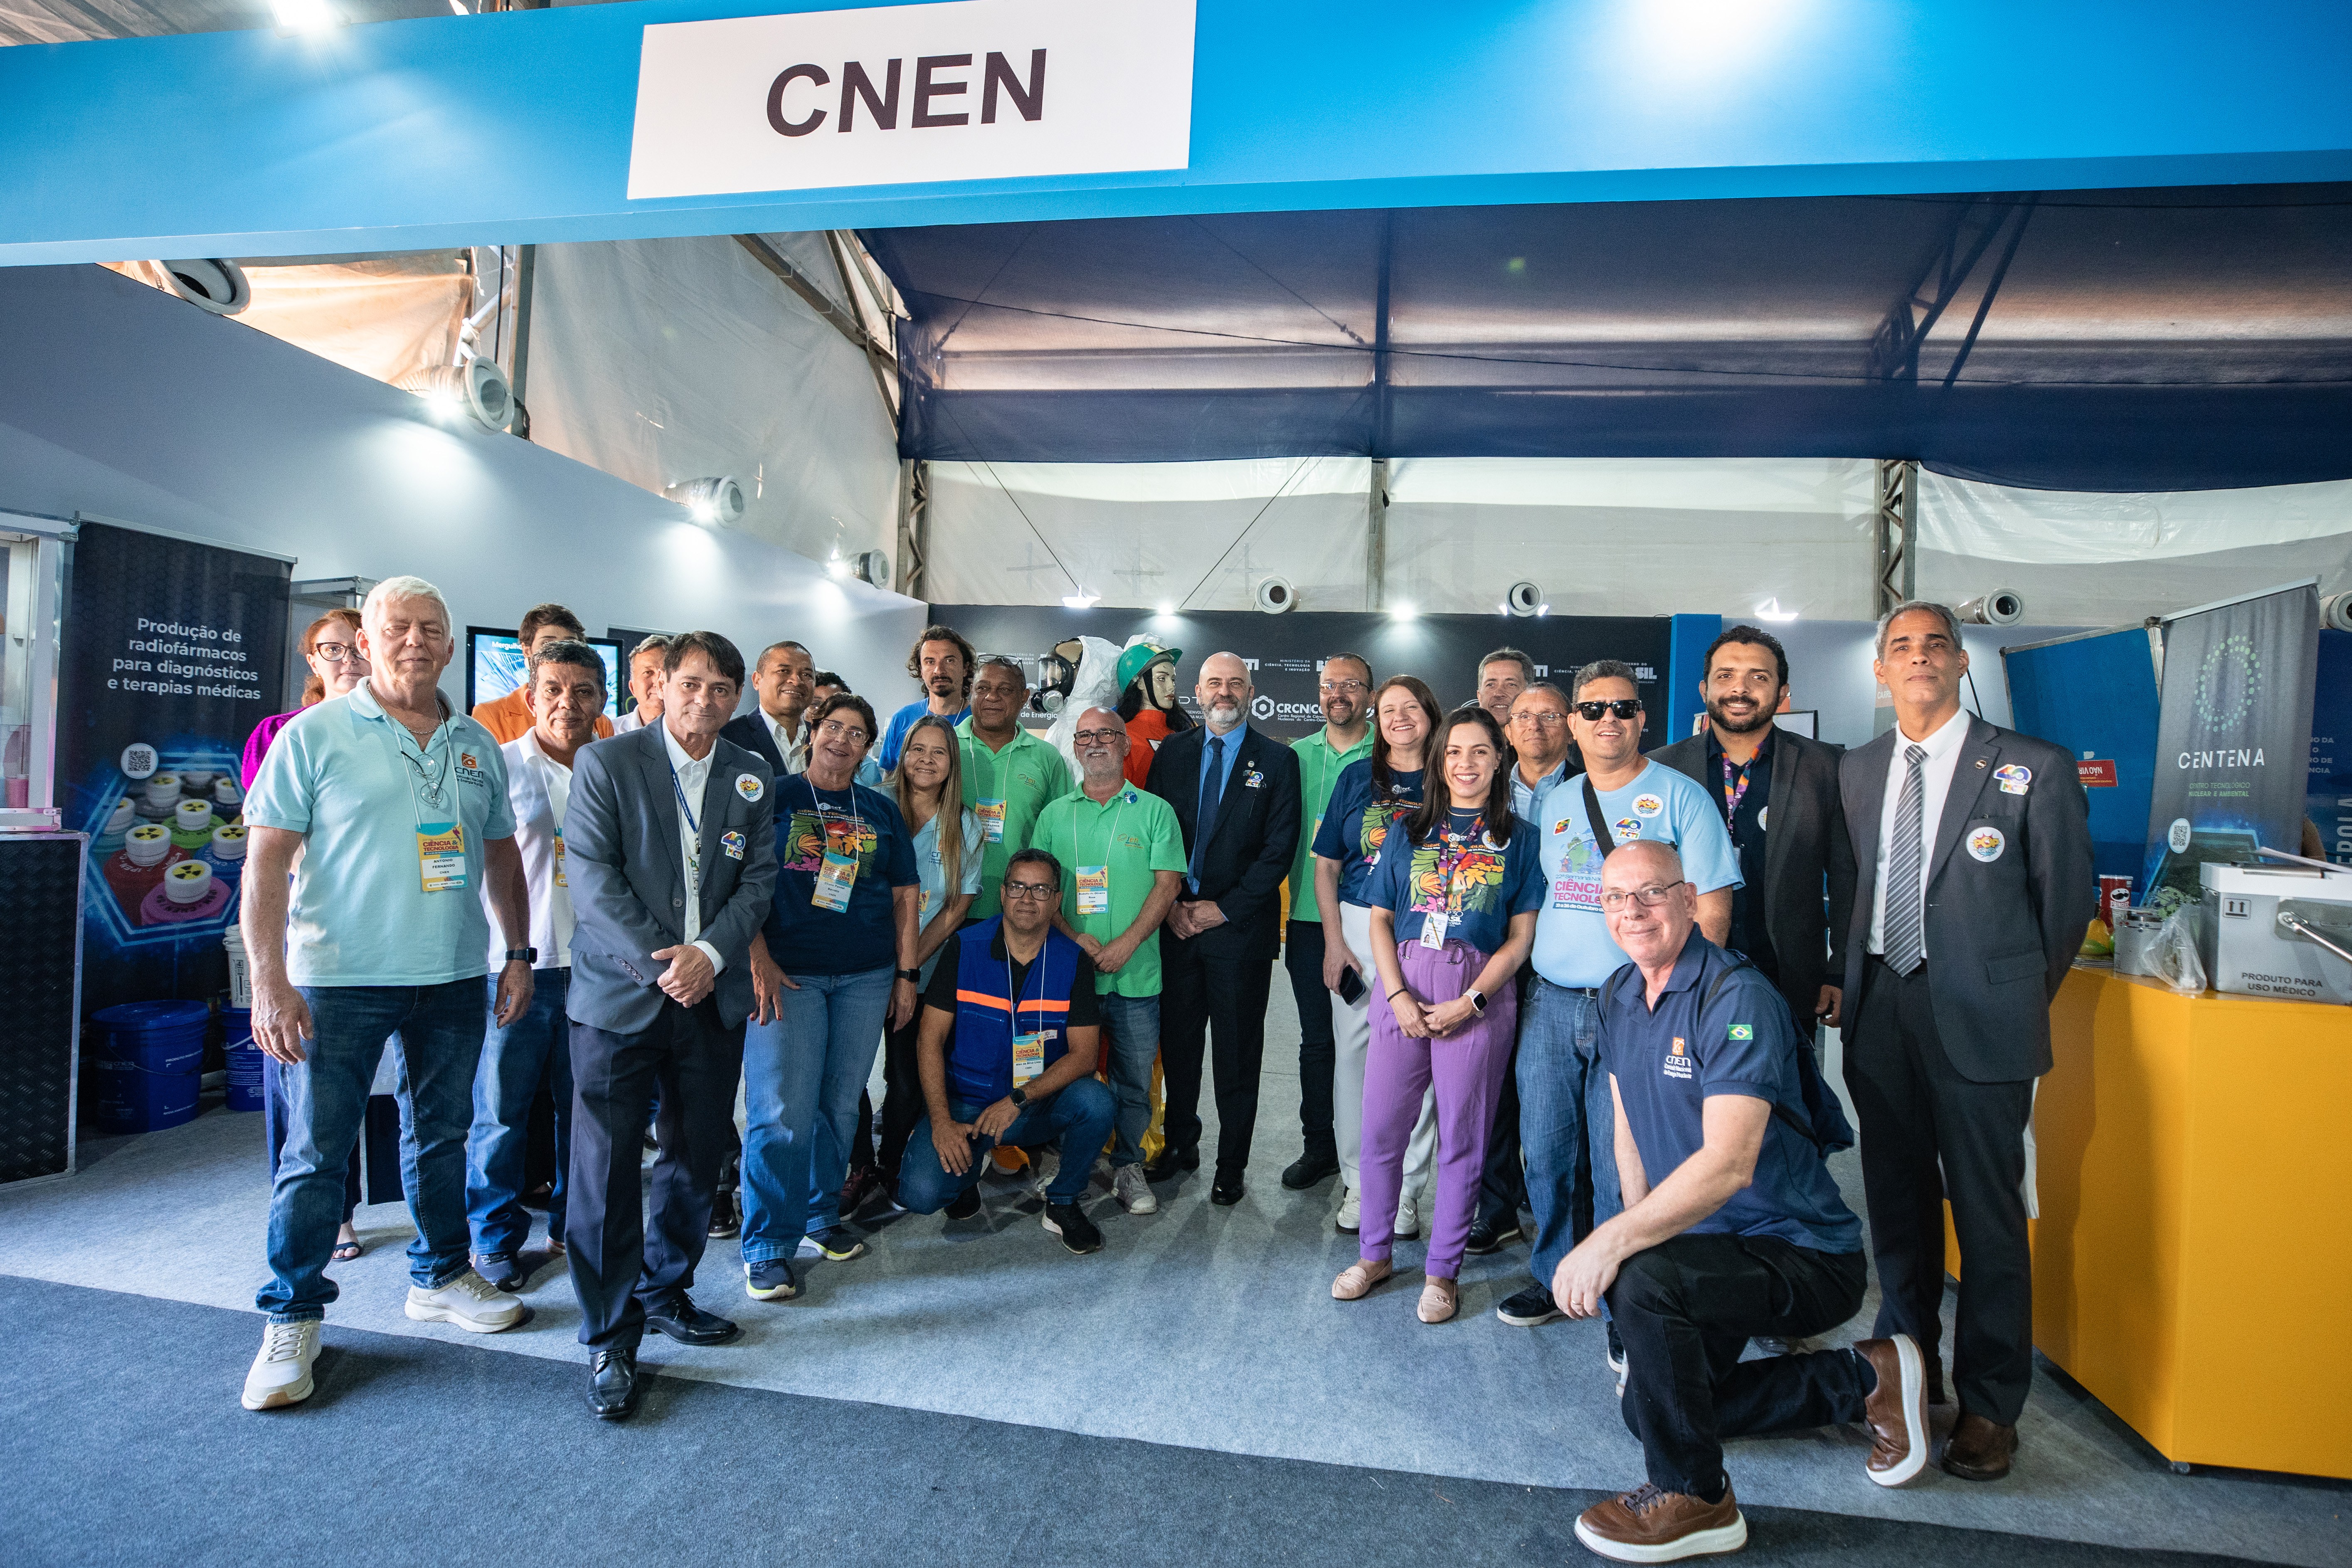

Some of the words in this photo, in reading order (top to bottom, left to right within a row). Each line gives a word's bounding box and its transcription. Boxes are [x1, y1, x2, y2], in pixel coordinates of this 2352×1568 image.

[766, 48, 1046, 137] CNEN
[138, 618, 217, 640] Produção
[222, 629, 242, 642] de
[129, 639, 247, 662] radiofármacos
[113, 658, 151, 672] para
[157, 660, 259, 681] diagnósticos
[107, 678, 118, 689] e
[123, 678, 192, 695] terapias
[197, 684, 261, 699] médicas
[2178, 748, 2265, 769] CENTENA
[2089, 767, 2103, 776] NÃO
[740, 781, 759, 790] POP
[1638, 800, 1659, 809] POP
[1616, 819, 1642, 831] 40
[722, 833, 745, 848] 40
[1973, 837, 1999, 848] POP
[2241, 972, 2292, 984] PRODUTO
[2294, 978, 2323, 987] PARA
[2248, 983, 2270, 991] USO
